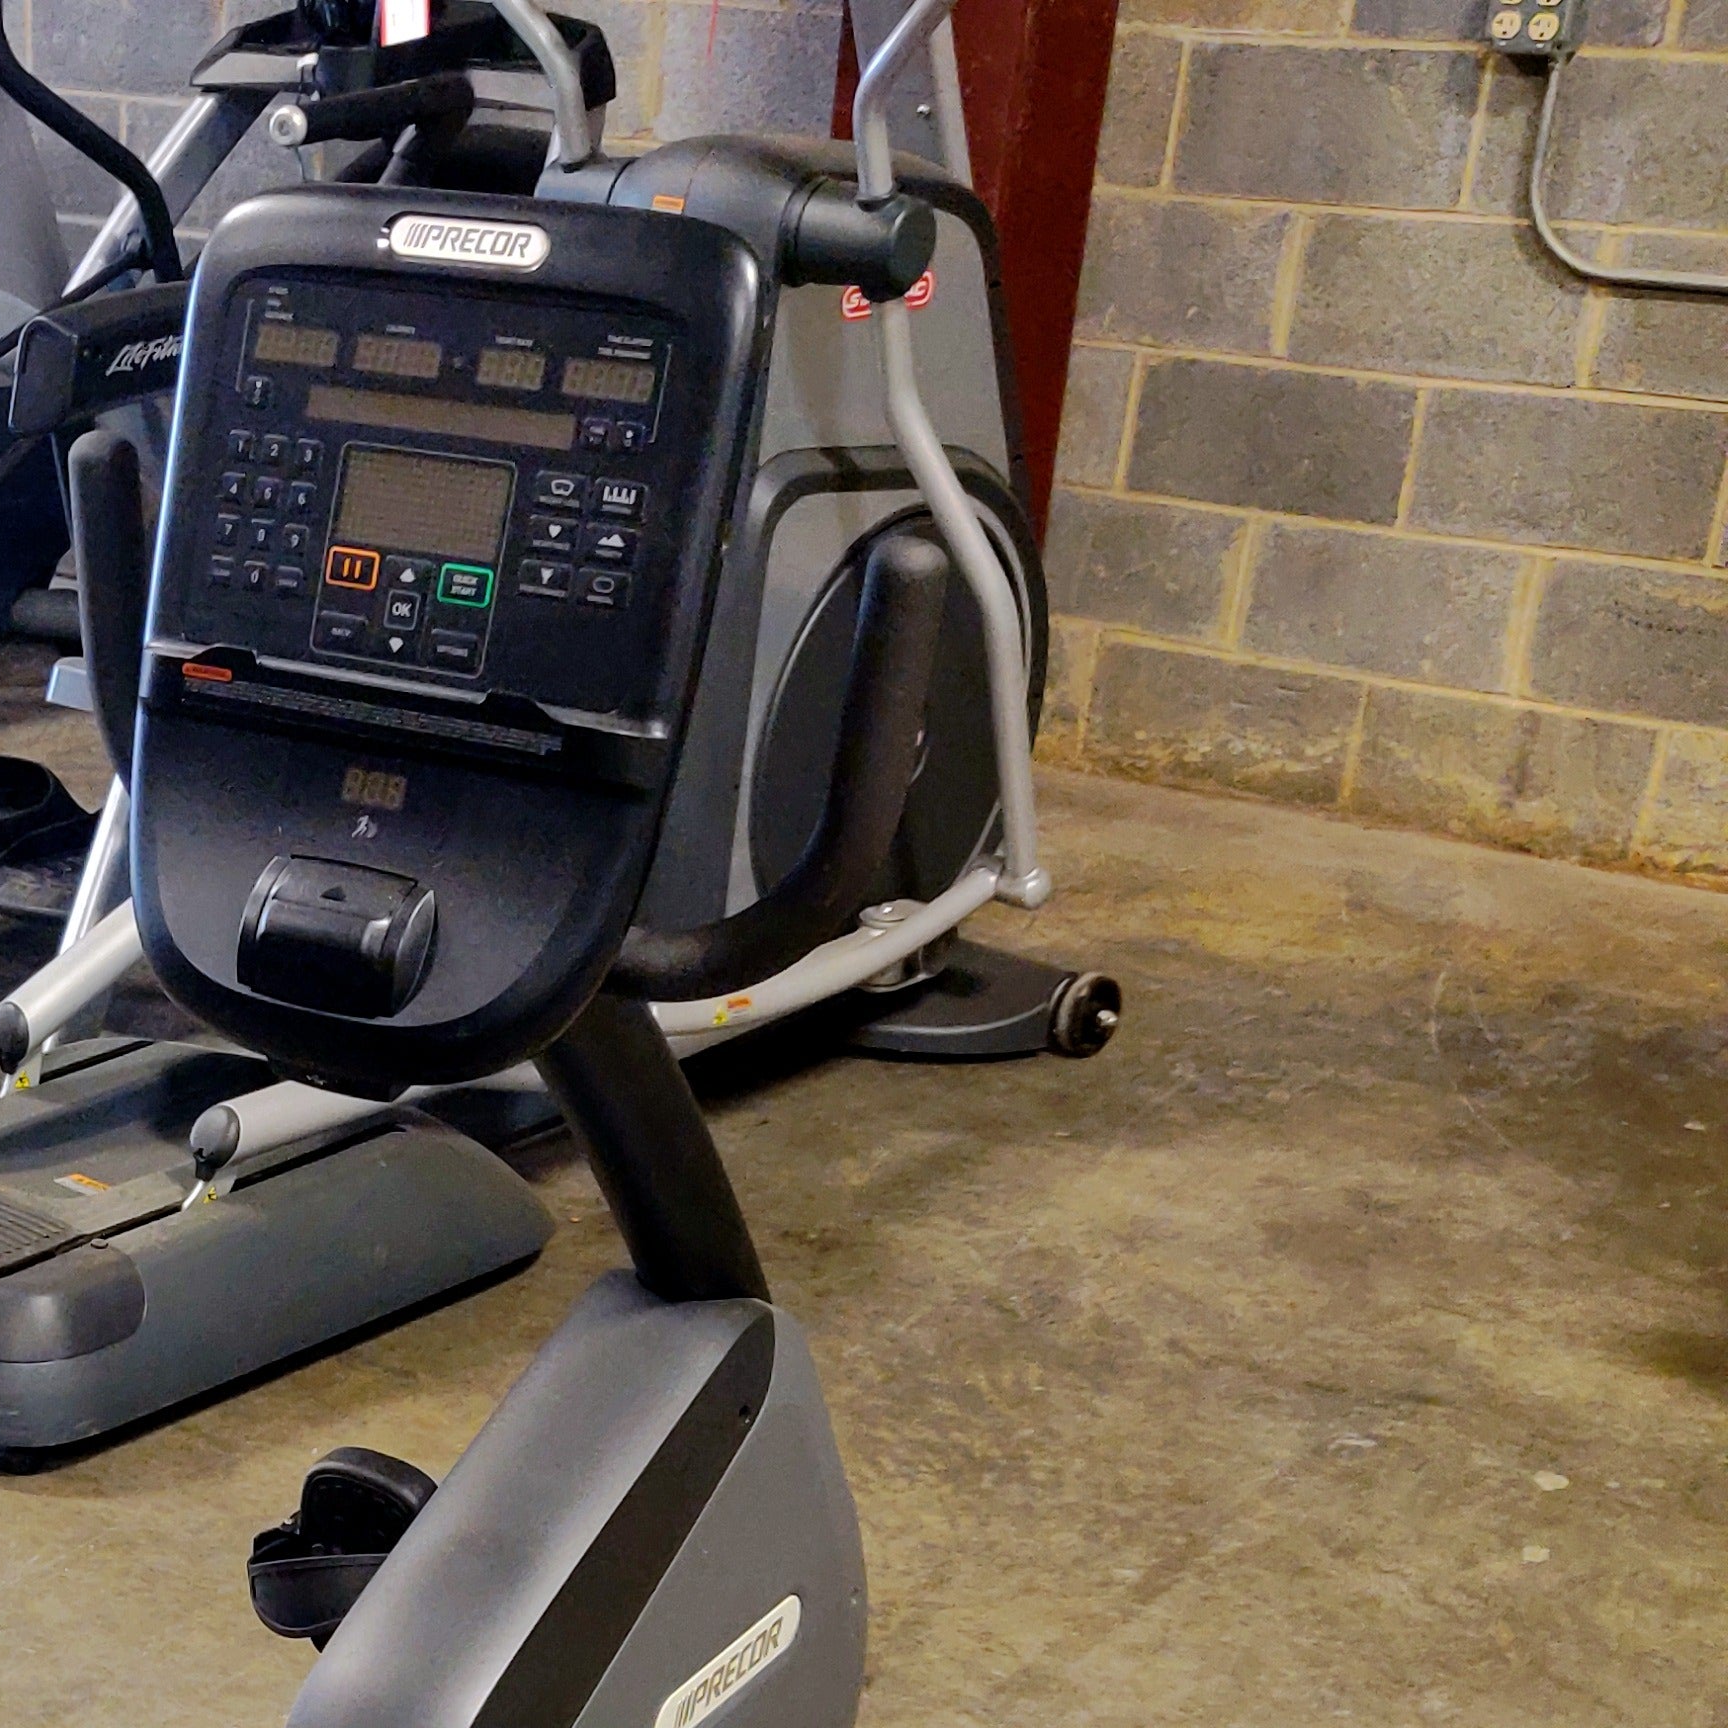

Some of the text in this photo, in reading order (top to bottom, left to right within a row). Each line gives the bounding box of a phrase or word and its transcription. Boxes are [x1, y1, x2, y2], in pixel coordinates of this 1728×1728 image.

[413, 223, 532, 258] PRECOR
[270, 443, 279, 457] 2
[304, 449, 312, 463] 3
[224, 523, 233, 536] 7
[391, 601, 413, 618] OK
[684, 1615, 784, 1722] PRECOR
